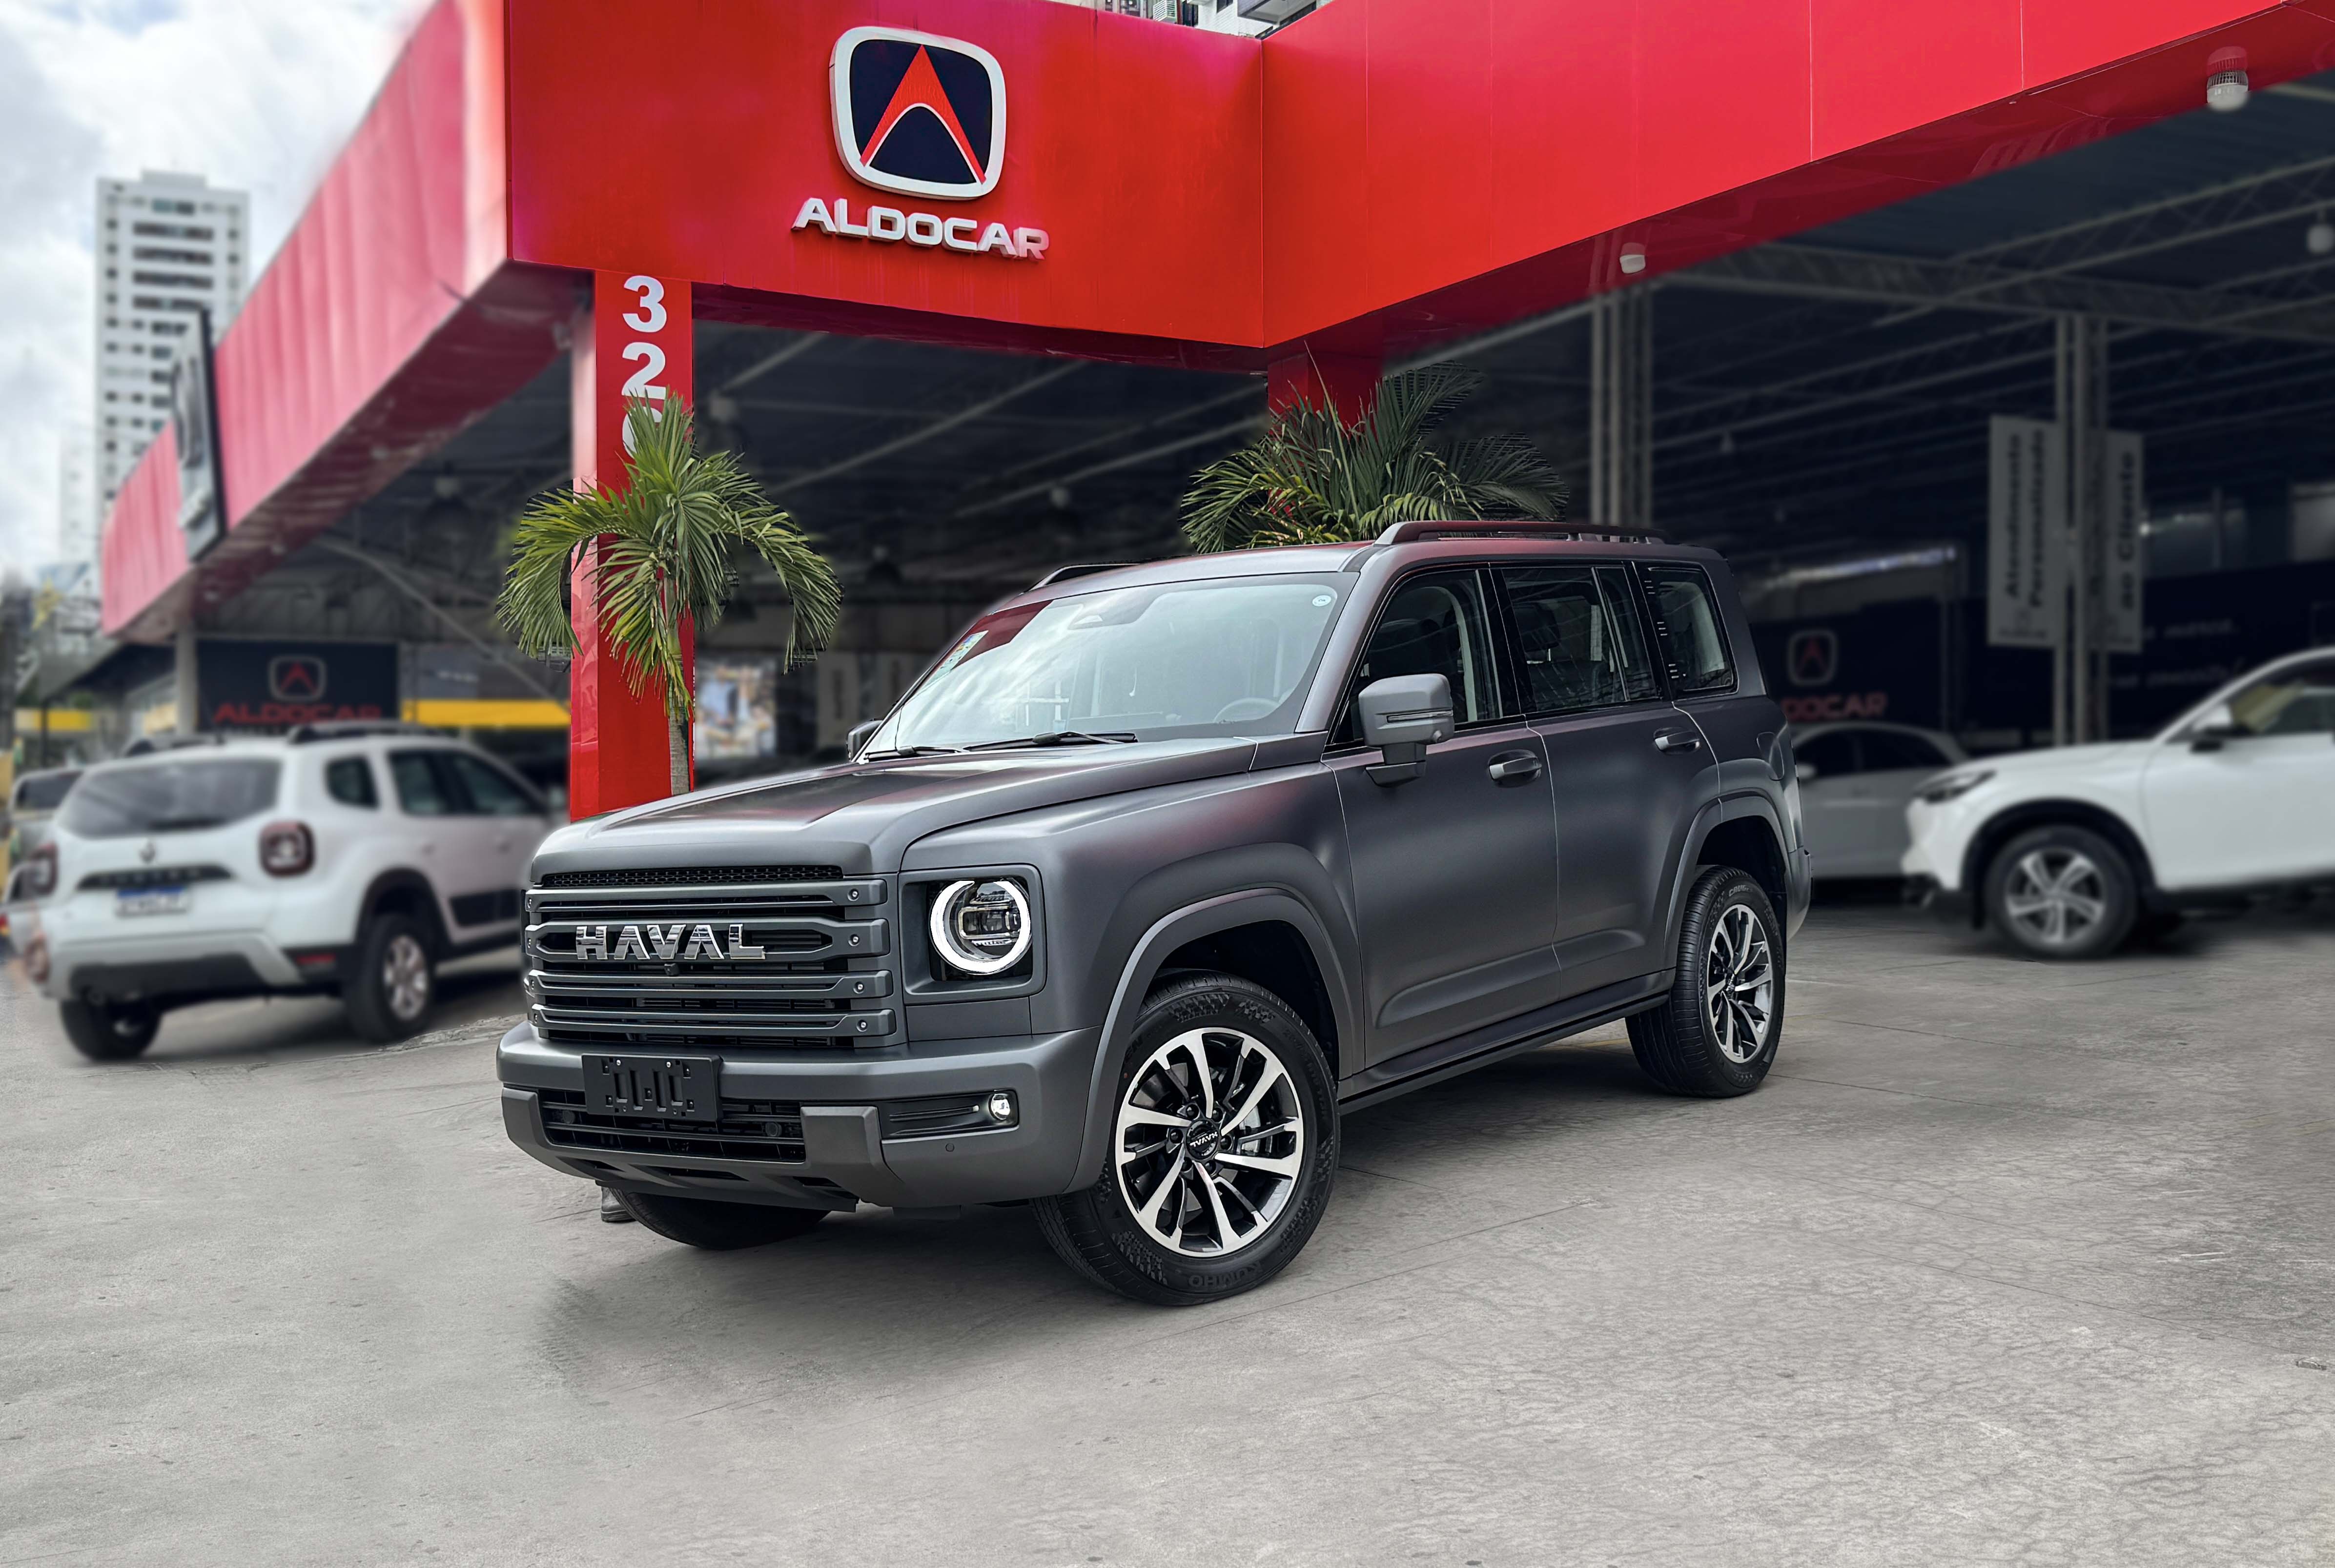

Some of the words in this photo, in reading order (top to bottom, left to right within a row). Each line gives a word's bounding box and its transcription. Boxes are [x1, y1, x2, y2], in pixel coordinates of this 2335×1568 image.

[790, 197, 1050, 260] ALDOCAR
[1781, 690, 1888, 721] DOCAR
[576, 924, 766, 960] HAVAL
[1188, 1260, 1262, 1288] KUMHO
